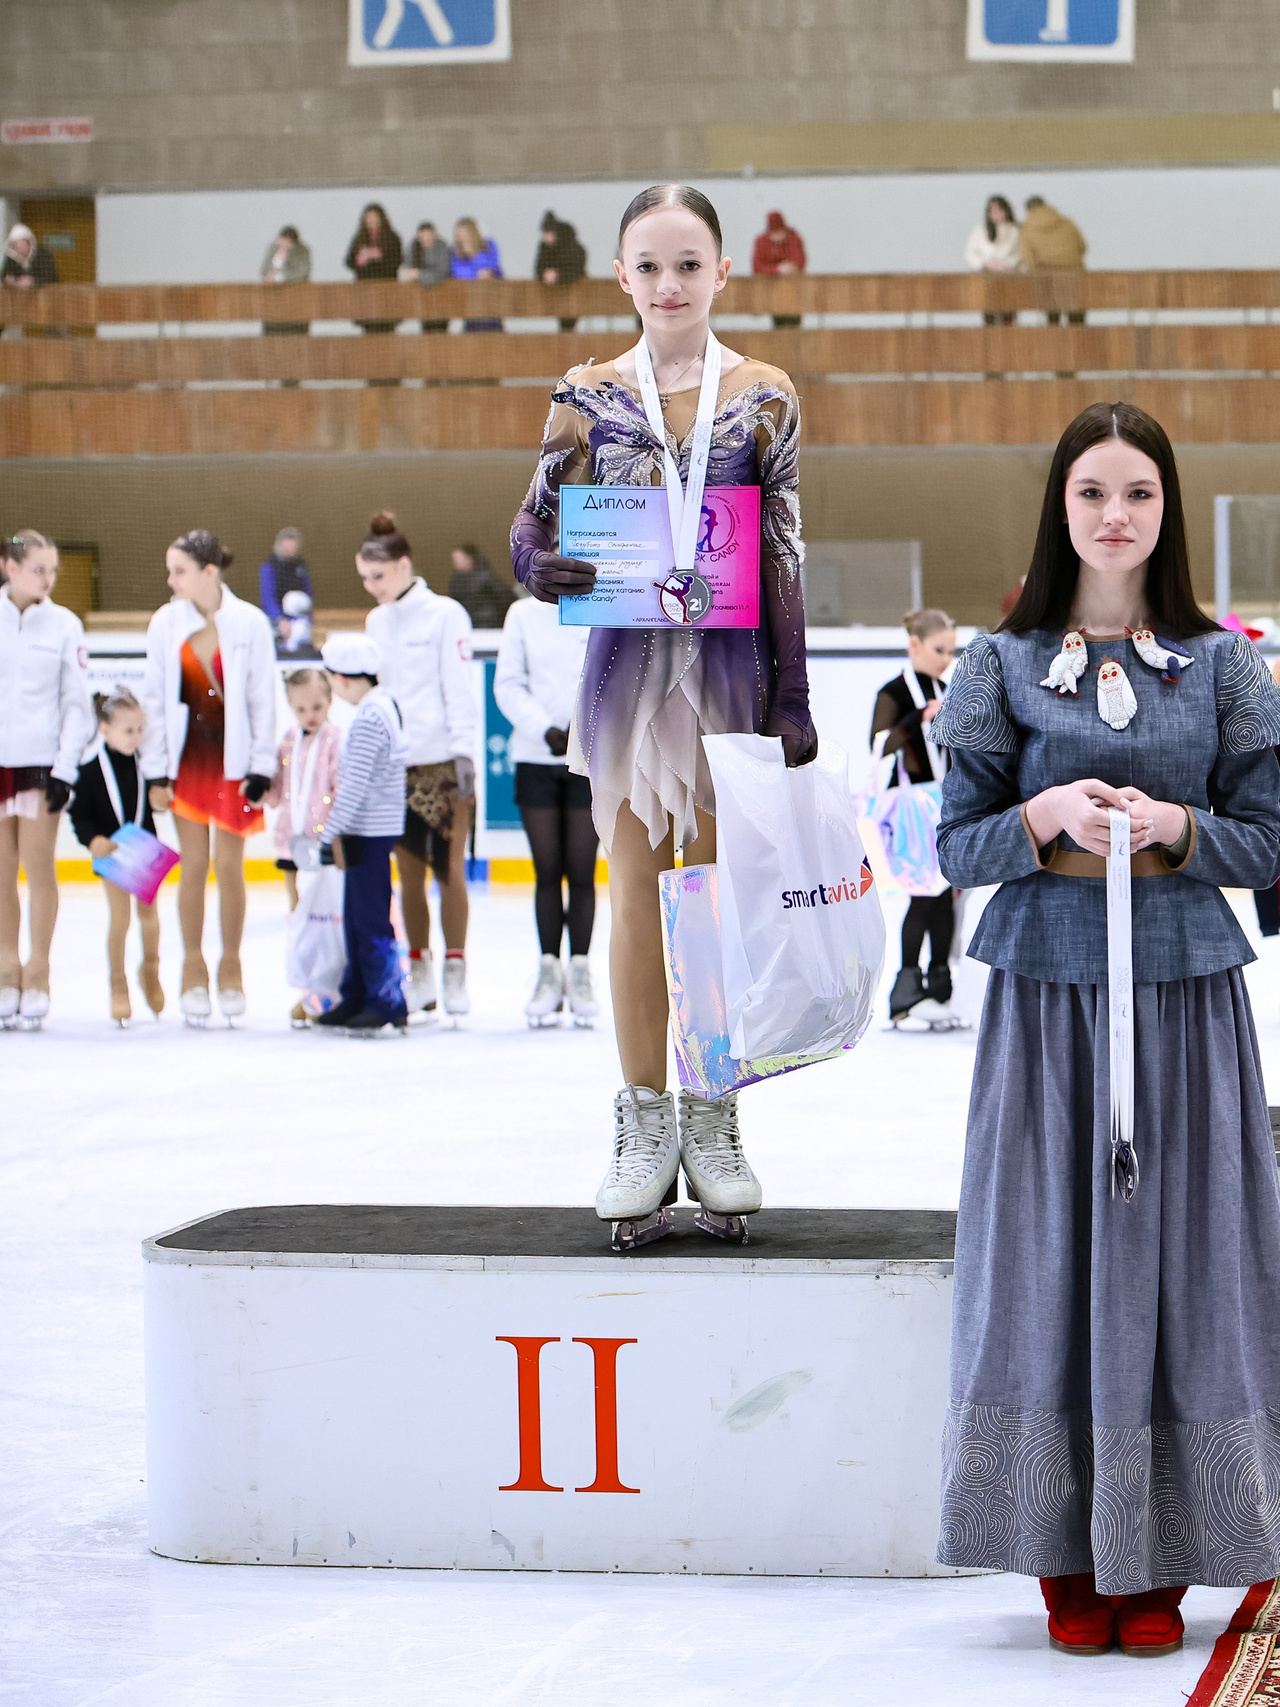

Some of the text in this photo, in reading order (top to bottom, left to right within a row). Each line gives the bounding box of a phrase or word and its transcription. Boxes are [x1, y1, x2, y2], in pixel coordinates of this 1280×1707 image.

[583, 494, 646, 510] Диплом
[709, 539, 741, 563] CANDY
[689, 598, 699, 612] 2
[781, 877, 858, 909] smartavia
[496, 1336, 640, 1494] II
